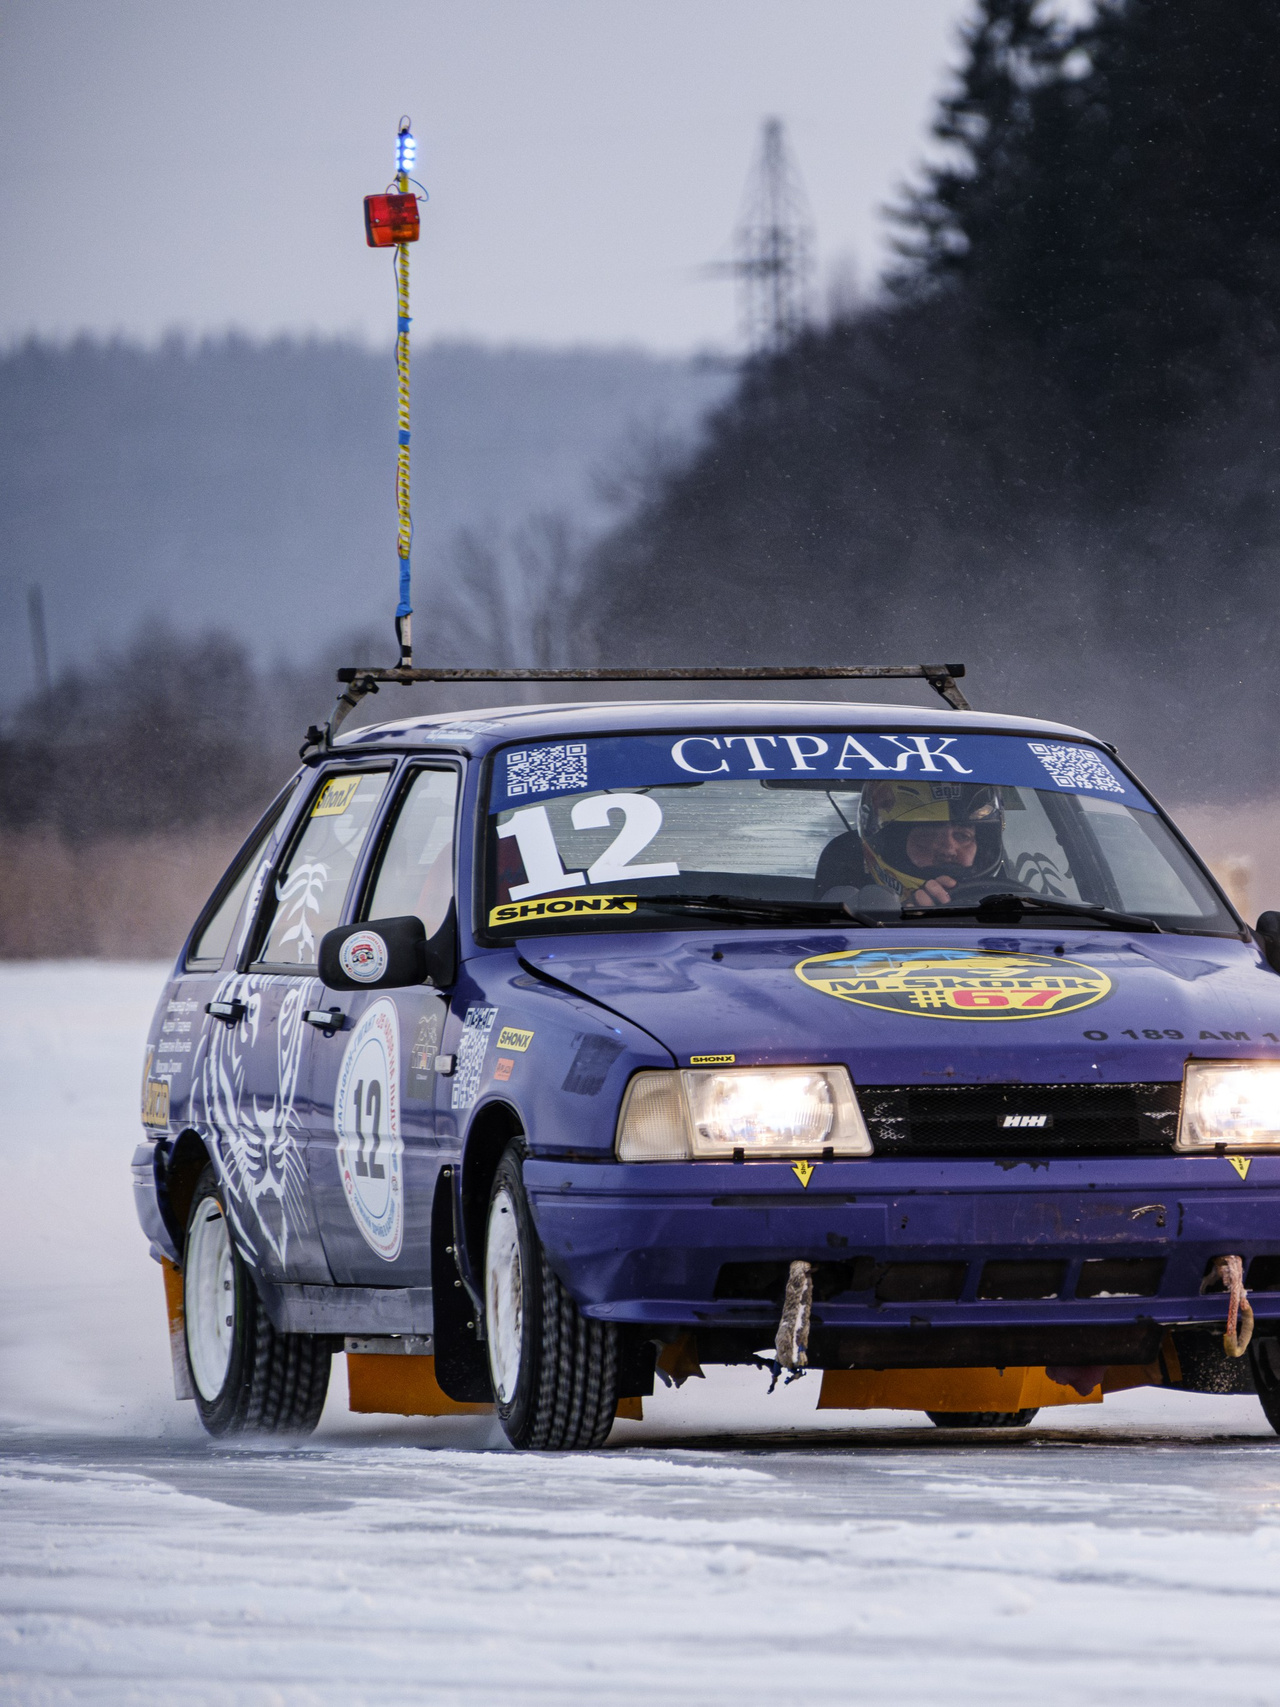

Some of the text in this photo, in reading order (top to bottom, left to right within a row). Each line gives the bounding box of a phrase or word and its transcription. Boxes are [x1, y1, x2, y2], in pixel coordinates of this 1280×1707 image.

[671, 735, 974, 774] СТРАЖ
[496, 793, 680, 901] 12
[495, 897, 631, 920] SHONX
[908, 989, 1063, 1008] #67
[500, 1030, 531, 1048] SHONX
[1121, 1029, 1185, 1041] 189
[692, 1055, 733, 1063] SHONX
[354, 1079, 386, 1180] 12
